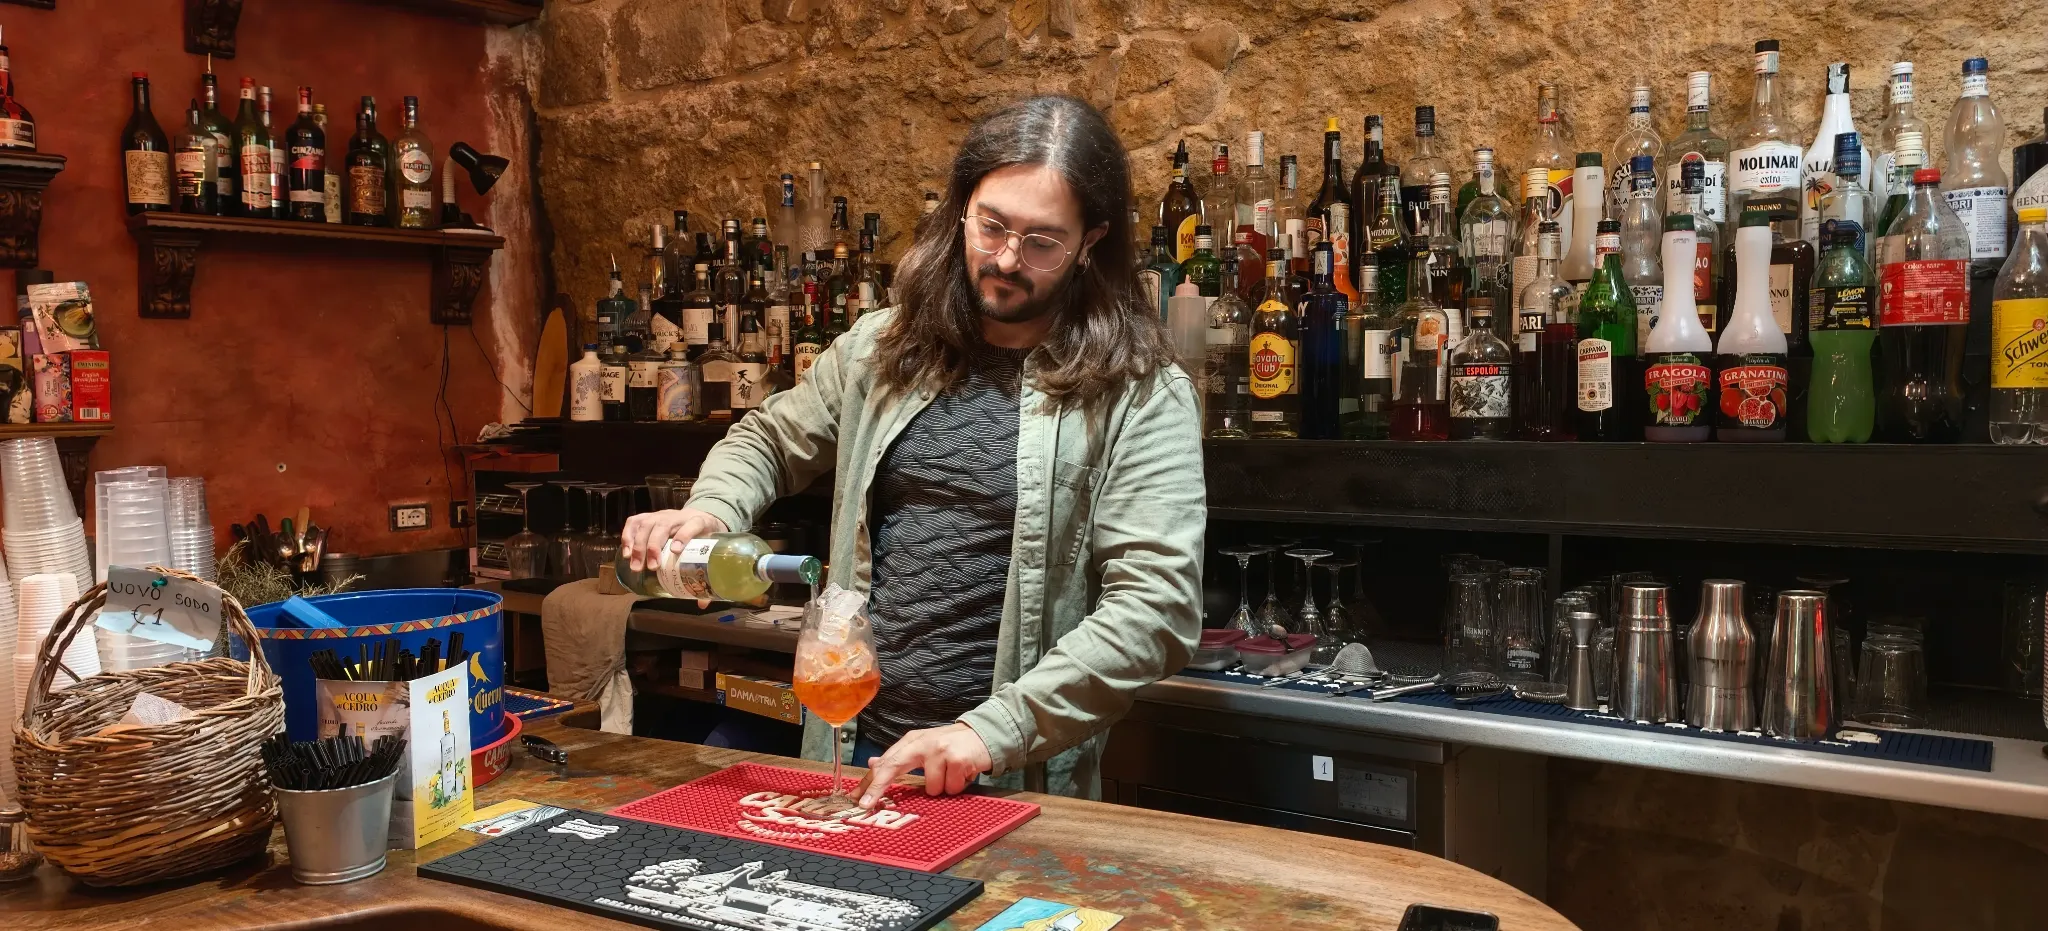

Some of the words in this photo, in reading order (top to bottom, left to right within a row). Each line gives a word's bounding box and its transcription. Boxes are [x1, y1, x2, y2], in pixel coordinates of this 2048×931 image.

[292, 146, 325, 157] CINZANO
[1739, 156, 1799, 171] MOLINARI
[1760, 176, 1781, 184] extra
[1837, 287, 1866, 298] LEMON
[1256, 363, 1276, 372] Club
[1648, 367, 1707, 380] FRAGOLA
[1724, 370, 1787, 381] GRANATINA
[110, 582, 161, 600] UOVO
[175, 593, 210, 613] SODO
[130, 603, 164, 626] €1
[434, 678, 456, 695] ACQUA
[342, 692, 378, 704] ACQUA
[433, 687, 456, 704] CEDRO
[342, 702, 378, 712] CEDRO
[1321, 762, 1327, 775] 1
